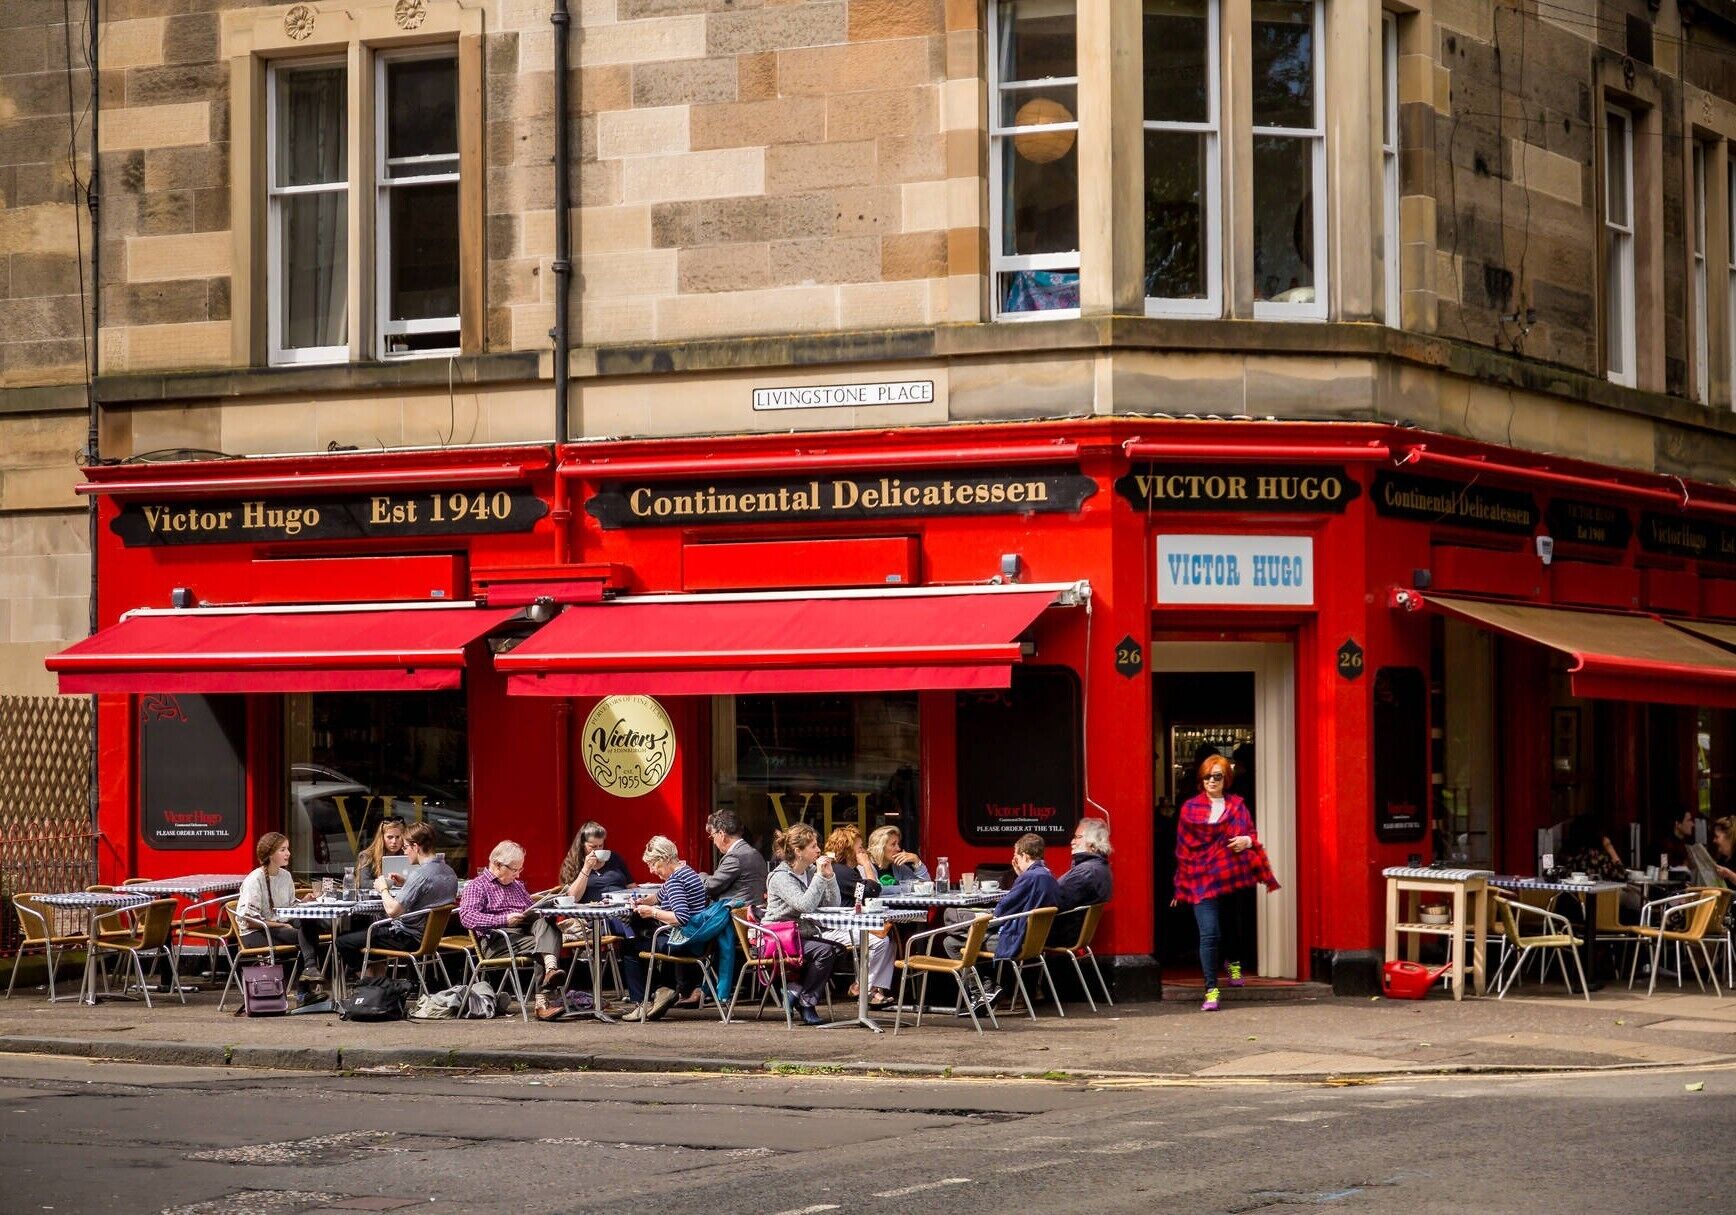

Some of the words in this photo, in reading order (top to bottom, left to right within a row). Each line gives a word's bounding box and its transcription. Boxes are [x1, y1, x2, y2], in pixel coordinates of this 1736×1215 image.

[756, 388, 867, 407] LIVINGSTONE
[878, 384, 930, 402] PLACE
[630, 481, 820, 517] Continental
[832, 477, 1048, 510] Delicatessen
[1134, 475, 1249, 499] VICTOR
[1256, 475, 1342, 500] HUGO
[143, 505, 232, 533] Victor
[241, 501, 320, 535] Hugo
[370, 496, 417, 524] Est
[429, 491, 512, 523] 1940
[1384, 481, 1456, 516] Continental
[1459, 492, 1531, 526] Delicatessen
[1167, 553, 1241, 586] VICTOR
[1252, 555, 1303, 587] HUGO
[1117, 649, 1141, 665] 26
[1339, 651, 1362, 667] 26
[618, 775, 640, 788] 1955
[986, 803, 1020, 817] Victor
[1022, 803, 1057, 821] Hugo
